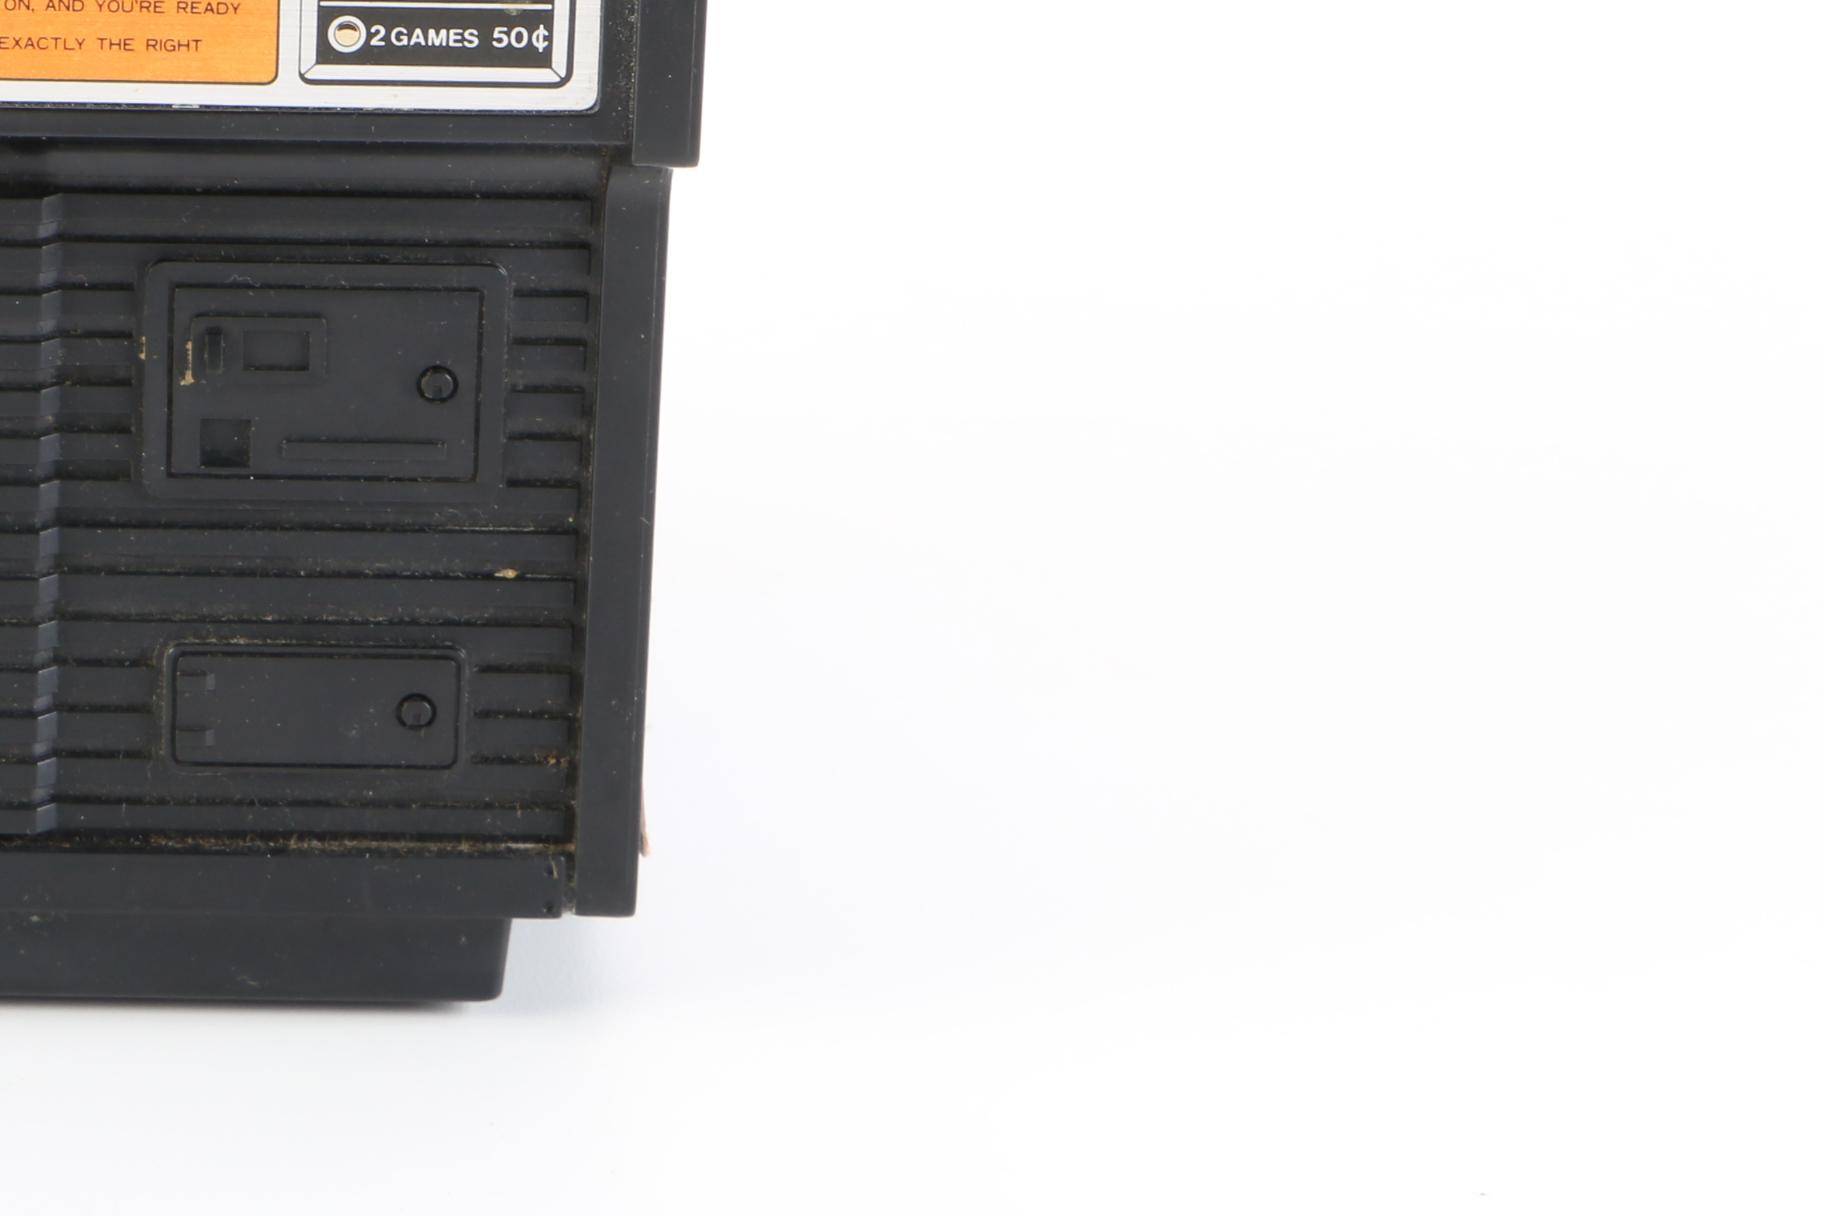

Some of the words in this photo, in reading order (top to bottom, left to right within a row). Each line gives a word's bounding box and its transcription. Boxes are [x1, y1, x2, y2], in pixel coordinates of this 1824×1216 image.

[45, 0, 85, 12] AND
[96, 0, 165, 13] YOU'RE
[177, 1, 241, 15] READY
[370, 25, 385, 46] 2
[390, 28, 479, 47] GAMES
[97, 38, 134, 51] THE
[146, 38, 203, 52] RIGHT
